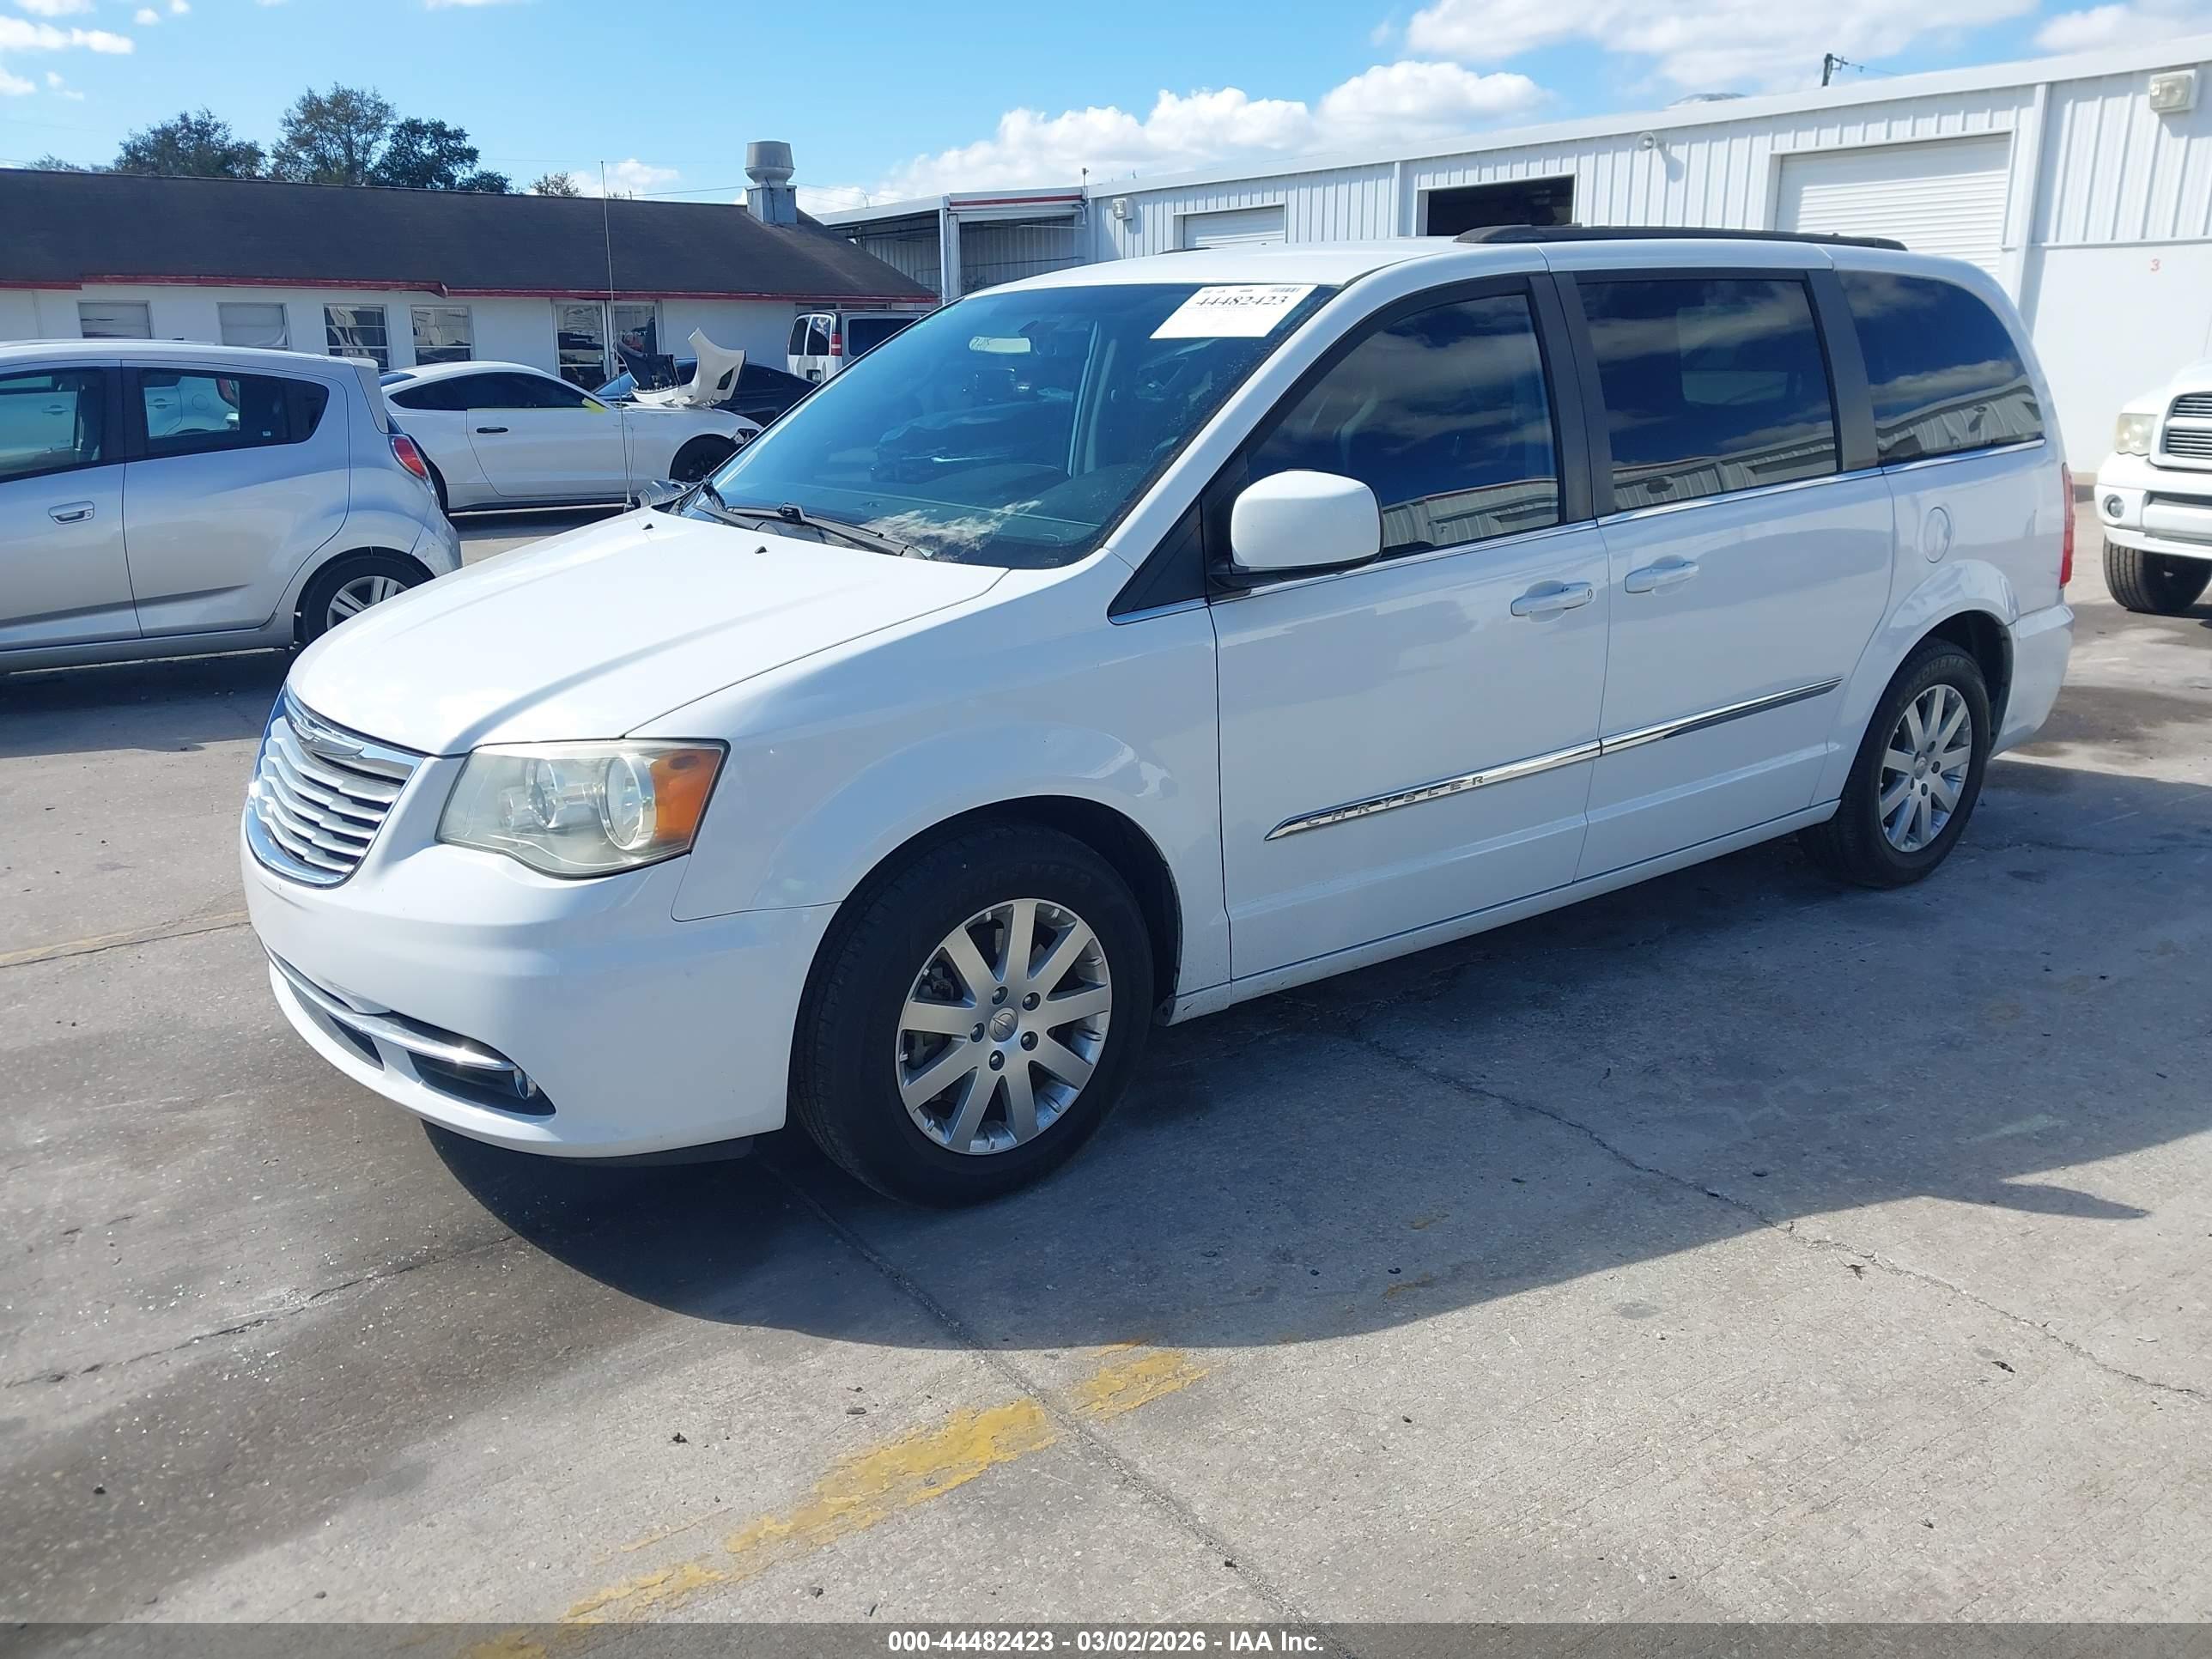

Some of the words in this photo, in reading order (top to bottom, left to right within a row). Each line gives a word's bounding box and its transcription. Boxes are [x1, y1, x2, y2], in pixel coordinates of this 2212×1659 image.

[2150, 258, 2161, 272] 3
[1195, 295, 1289, 307] 44482423
[1306, 775, 1485, 826] CHRYSLER
